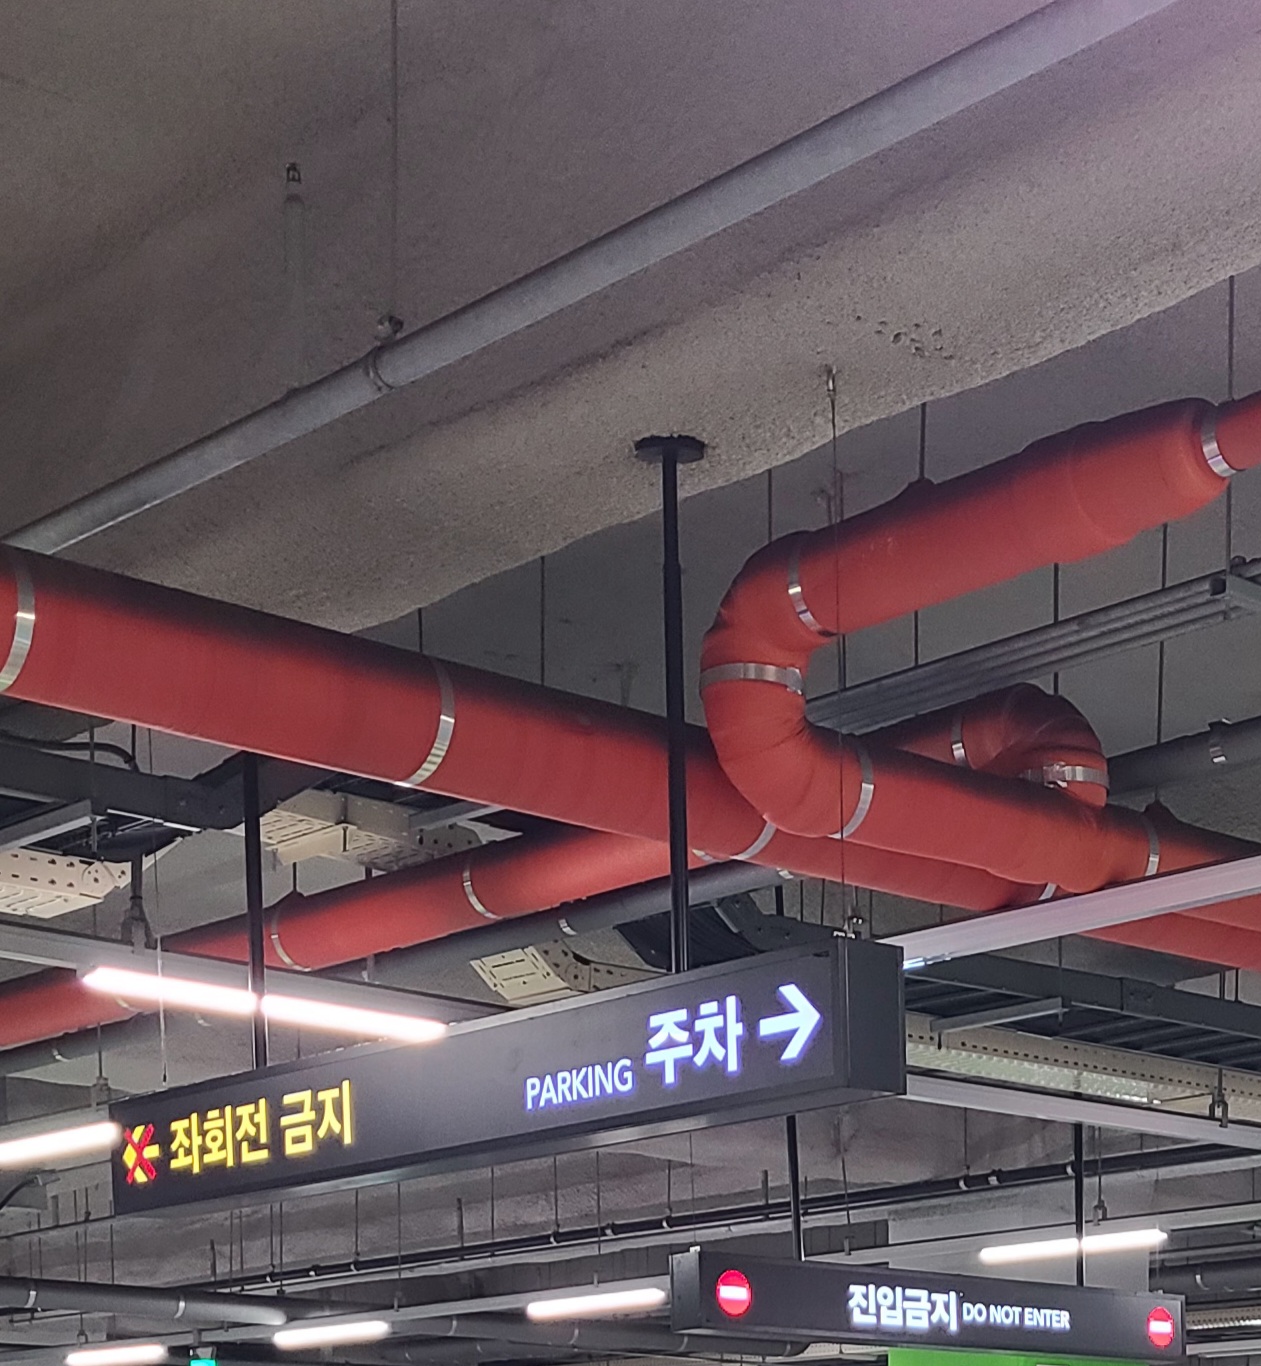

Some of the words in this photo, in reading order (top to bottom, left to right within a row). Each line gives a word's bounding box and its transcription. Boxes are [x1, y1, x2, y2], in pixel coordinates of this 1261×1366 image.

[645, 995, 743, 1084] 주차
[526, 1058, 633, 1109] PARKING
[170, 1097, 269, 1173] 좌회전
[280, 1079, 352, 1155] 금지
[848, 1284, 958, 1331] 진입금지
[963, 1302, 987, 1321] DO
[989, 1304, 1023, 1325] NOT
[1024, 1308, 1071, 1330] ENTER
